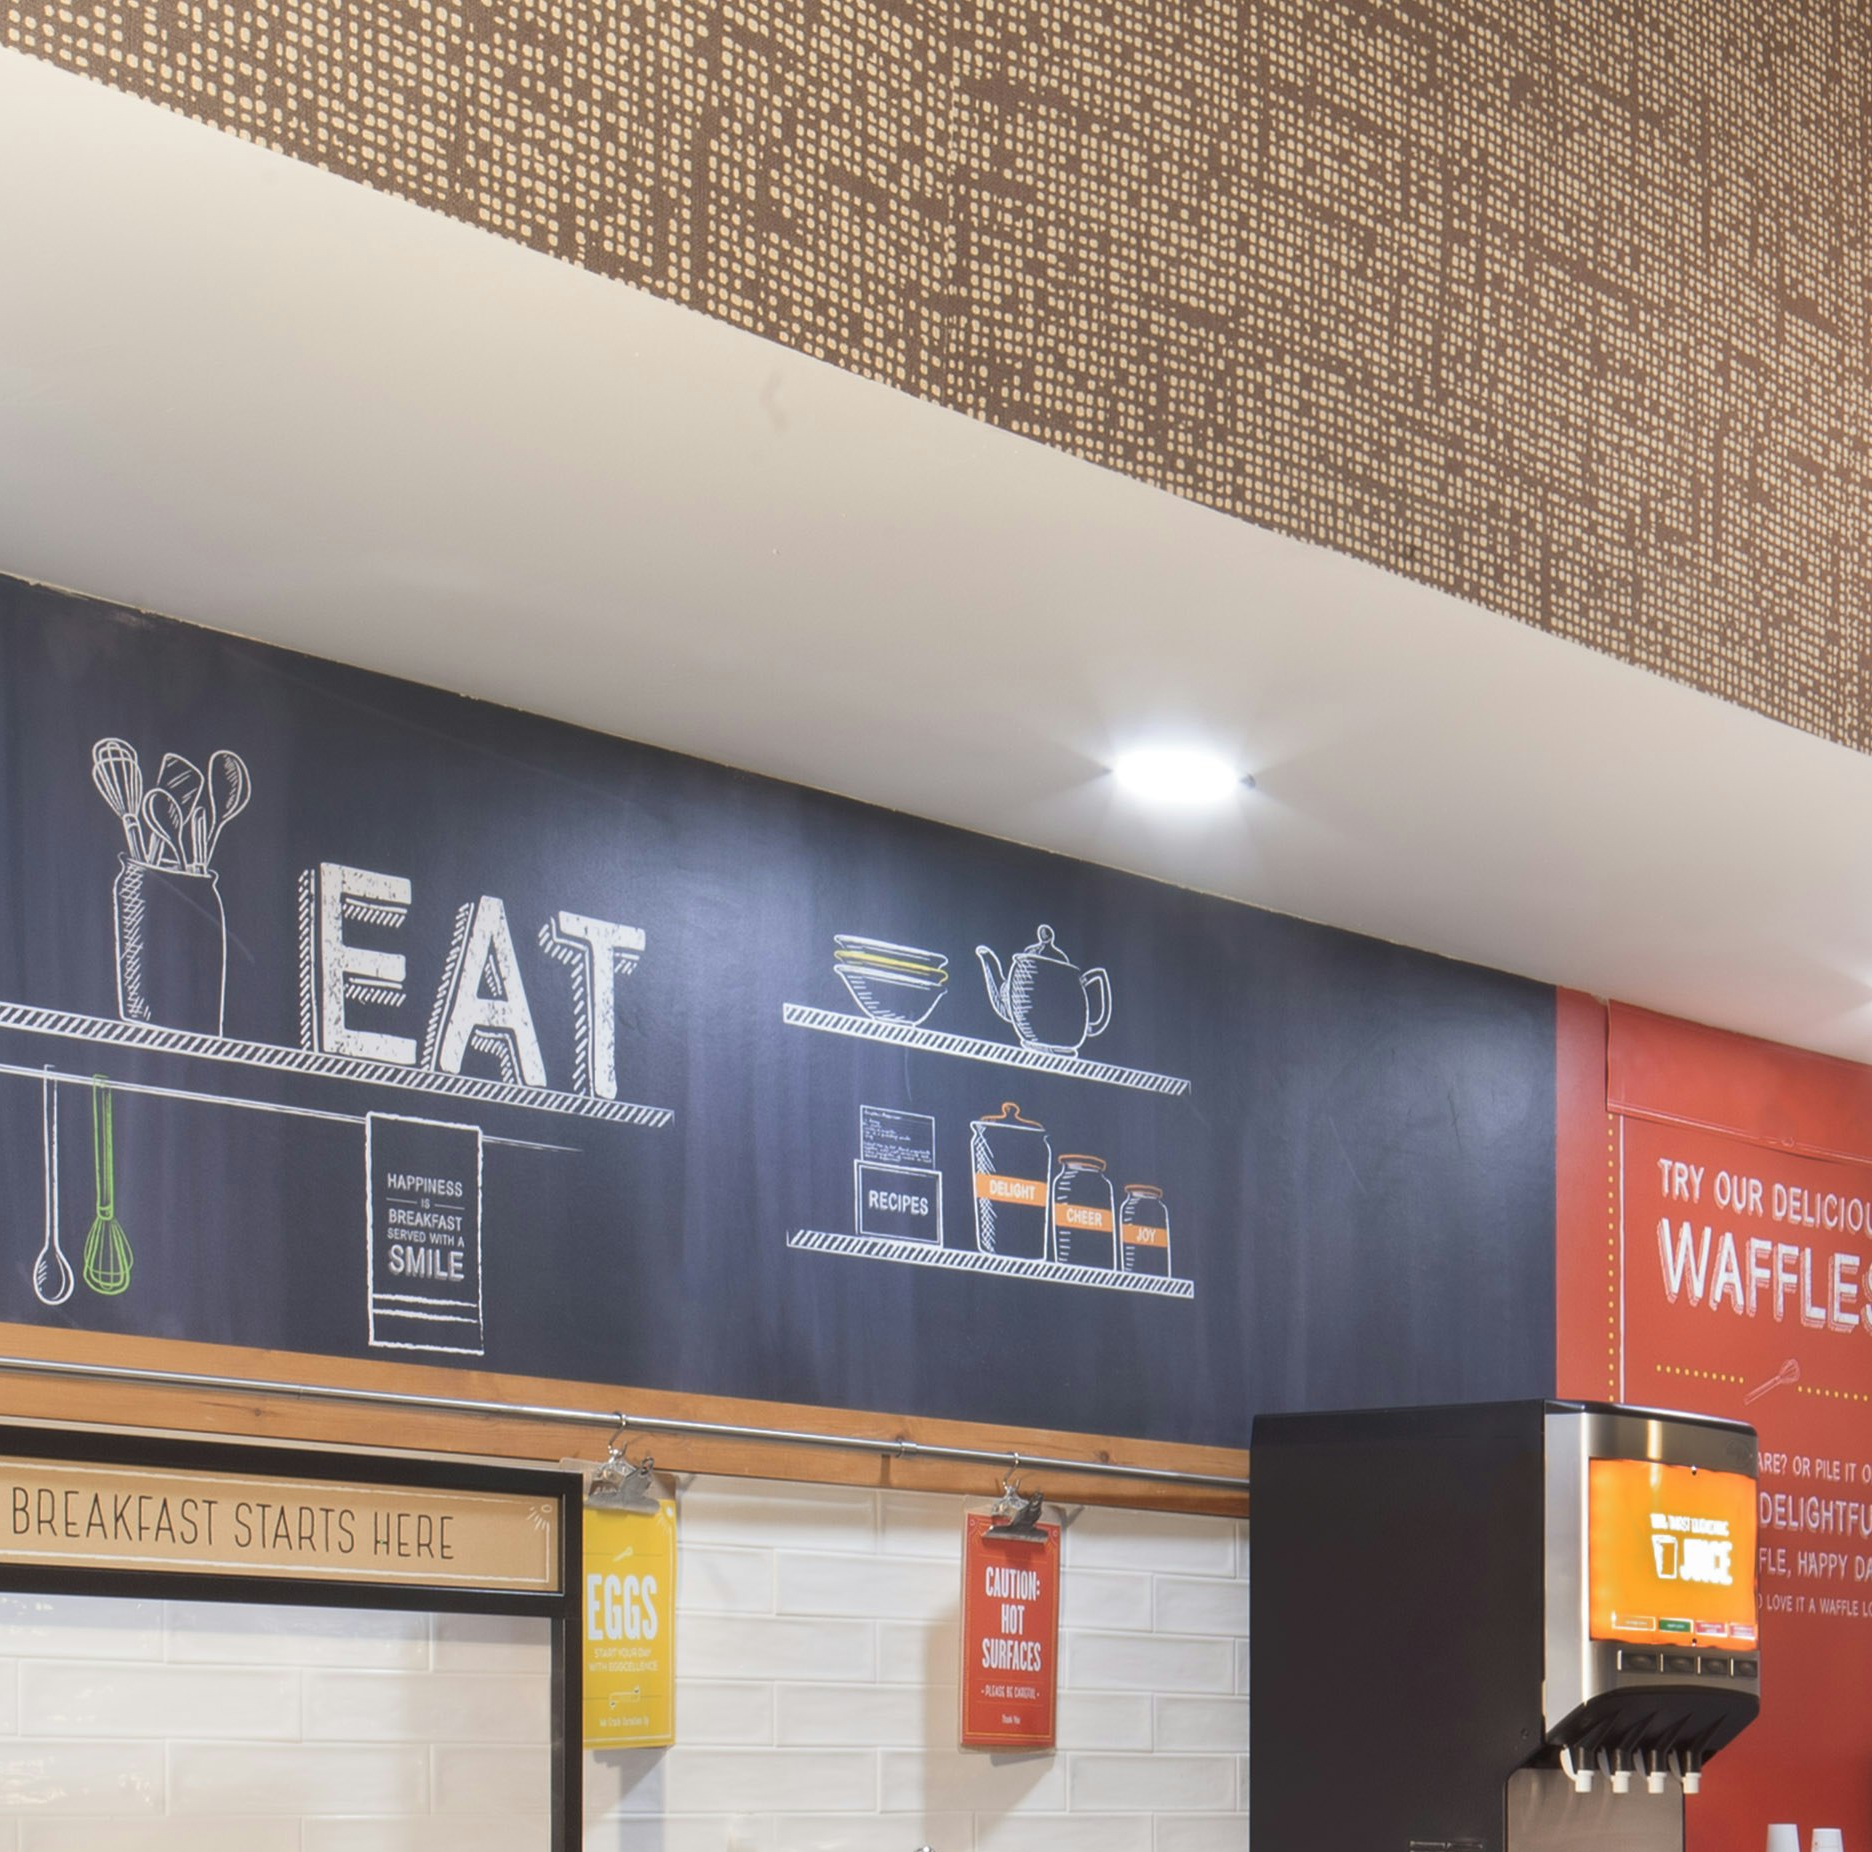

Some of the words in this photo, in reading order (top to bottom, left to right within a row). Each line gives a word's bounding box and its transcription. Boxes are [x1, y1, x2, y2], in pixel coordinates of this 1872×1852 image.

[299, 861, 646, 1100] EAT
[387, 1173, 463, 1198] HAPPINESS
[989, 1179, 1036, 1200] DELIGHT
[1657, 1157, 1704, 1202] TRY
[1714, 1170, 1764, 1217] OUR
[421, 1199, 430, 1209] IS
[868, 1190, 929, 1216] RECIPES
[389, 1209, 463, 1231] BREAKFAST
[1066, 1208, 1103, 1227] CHEER
[387, 1228, 426, 1242] SERVED
[429, 1233, 454, 1246] WITH
[457, 1236, 465, 1247] A
[1136, 1227, 1156, 1244] JOY
[388, 1245, 465, 1282] SMILE
[1793, 1456, 1810, 1478] OR
[1816, 1459, 1840, 1481] PILE
[1845, 1463, 1856, 1482] IT
[12, 1486, 221, 1548] BREAKFAST
[233, 1502, 356, 1555] STARTS
[373, 1511, 457, 1560] HERE
[1798, 1551, 1847, 1579] HAPPY
[985, 1566, 1040, 1600] CAUTION:
[587, 1573, 657, 1641] EGGS
[1767, 1595, 1792, 1611] LOVE
[1796, 1597, 1805, 1609] IT
[1808, 1598, 1816, 1613] A
[1819, 1599, 1859, 1616] WAFFLE
[1001, 1603, 1025, 1635] HOT
[982, 1638, 1041, 1672] SURFACES
